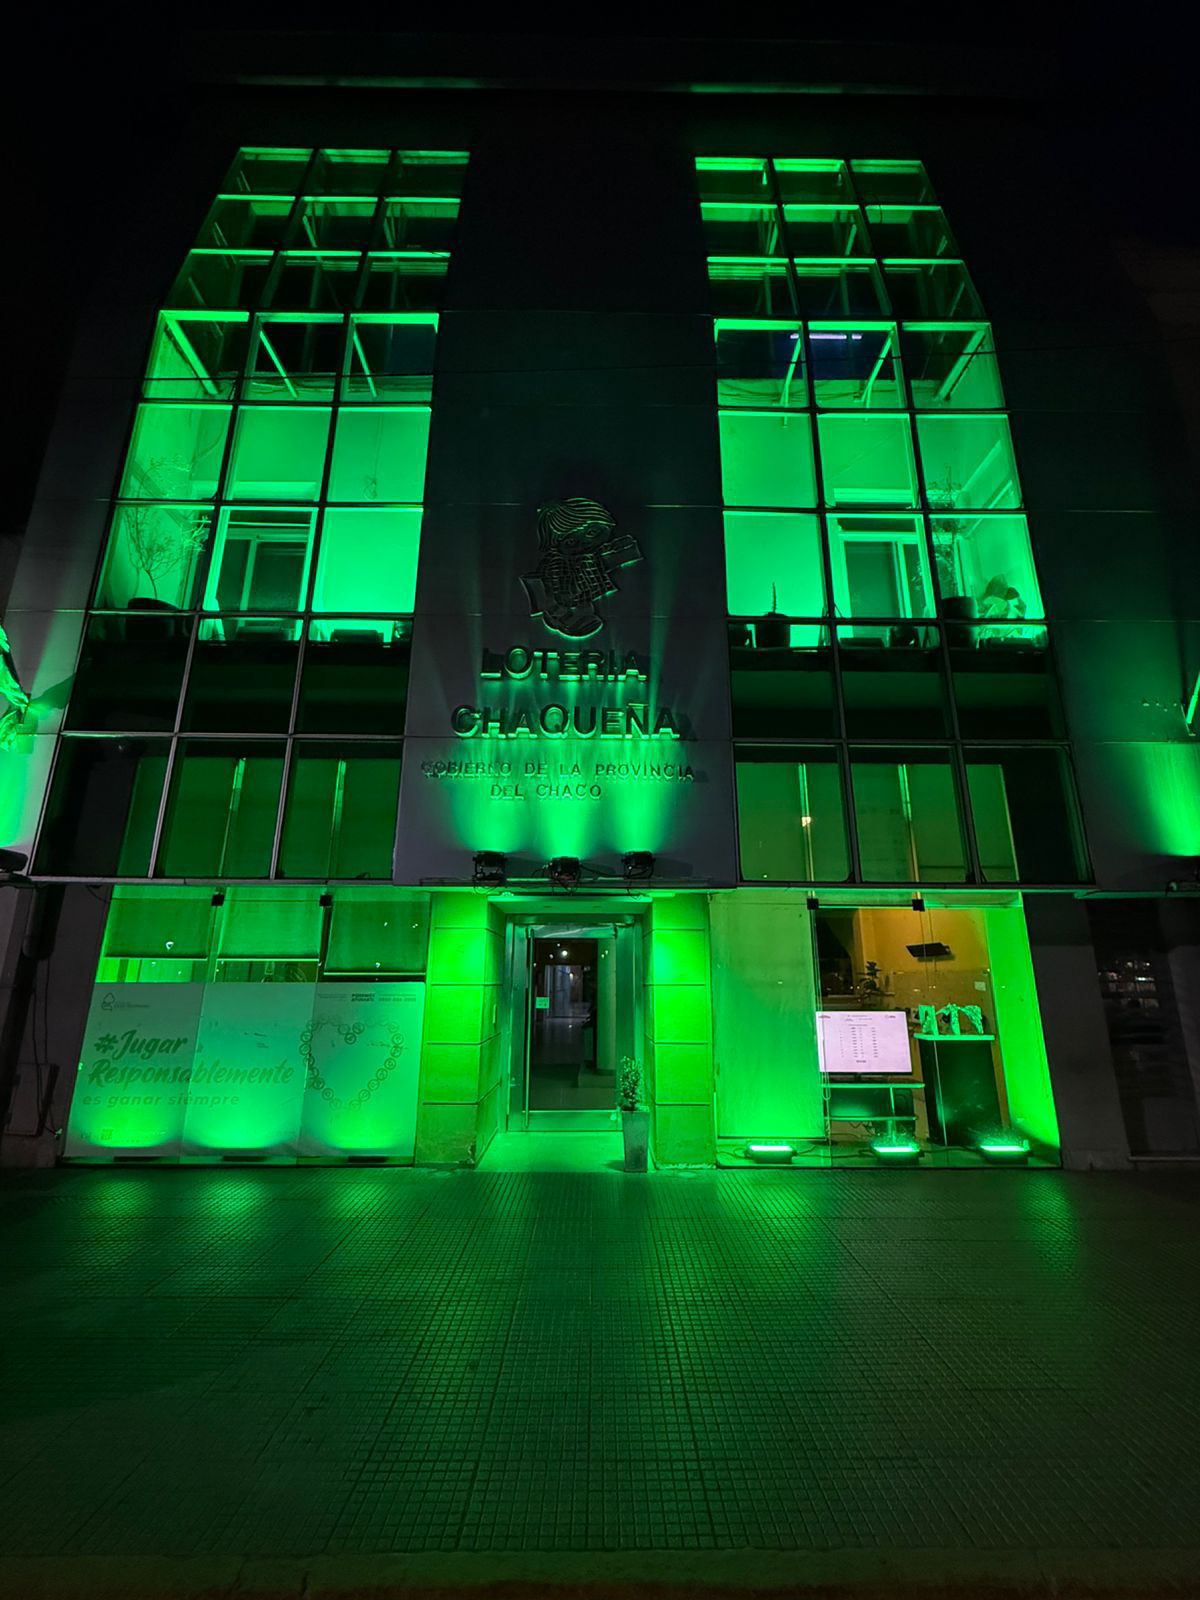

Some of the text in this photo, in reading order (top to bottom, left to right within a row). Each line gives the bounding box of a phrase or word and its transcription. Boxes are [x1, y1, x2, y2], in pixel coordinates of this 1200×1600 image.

[481, 647, 647, 680] LOTERIA
[451, 703, 680, 739] CHAQUEÑA
[421, 760, 695, 780] GOBIERNO DE LA PROVINCIA
[490, 784, 602, 800] DEL CHACO
[94, 1029, 188, 1060] #Jugar
[88, 1058, 294, 1090] Responsablemente
[82, 1094, 241, 1108] es ganar siempre
